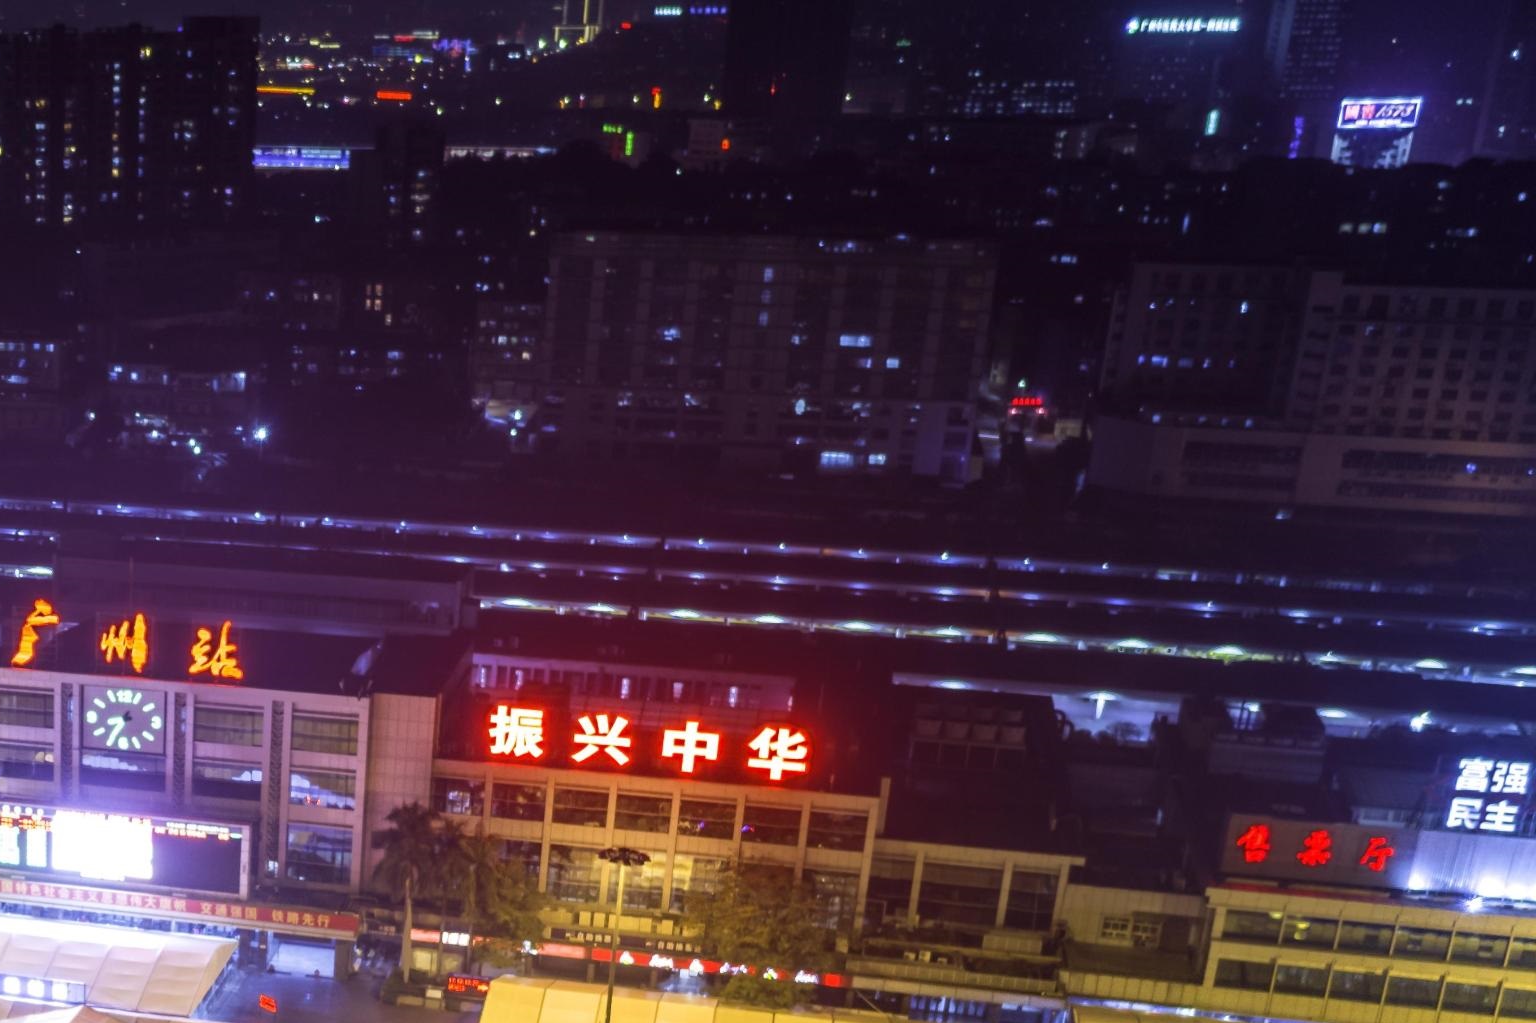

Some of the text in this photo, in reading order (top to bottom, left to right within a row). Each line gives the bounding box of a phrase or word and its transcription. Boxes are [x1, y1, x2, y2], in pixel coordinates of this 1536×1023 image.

[11, 598, 244, 680] 广州站
[488, 704, 810, 782] 振兴中华
[1454, 756, 1531, 795] 富强
[1445, 796, 1521, 833] 民主
[1236, 823, 1396, 873] 售票厅
[200, 901, 257, 921] 交通强国
[271, 909, 331, 929] 铁路先行
